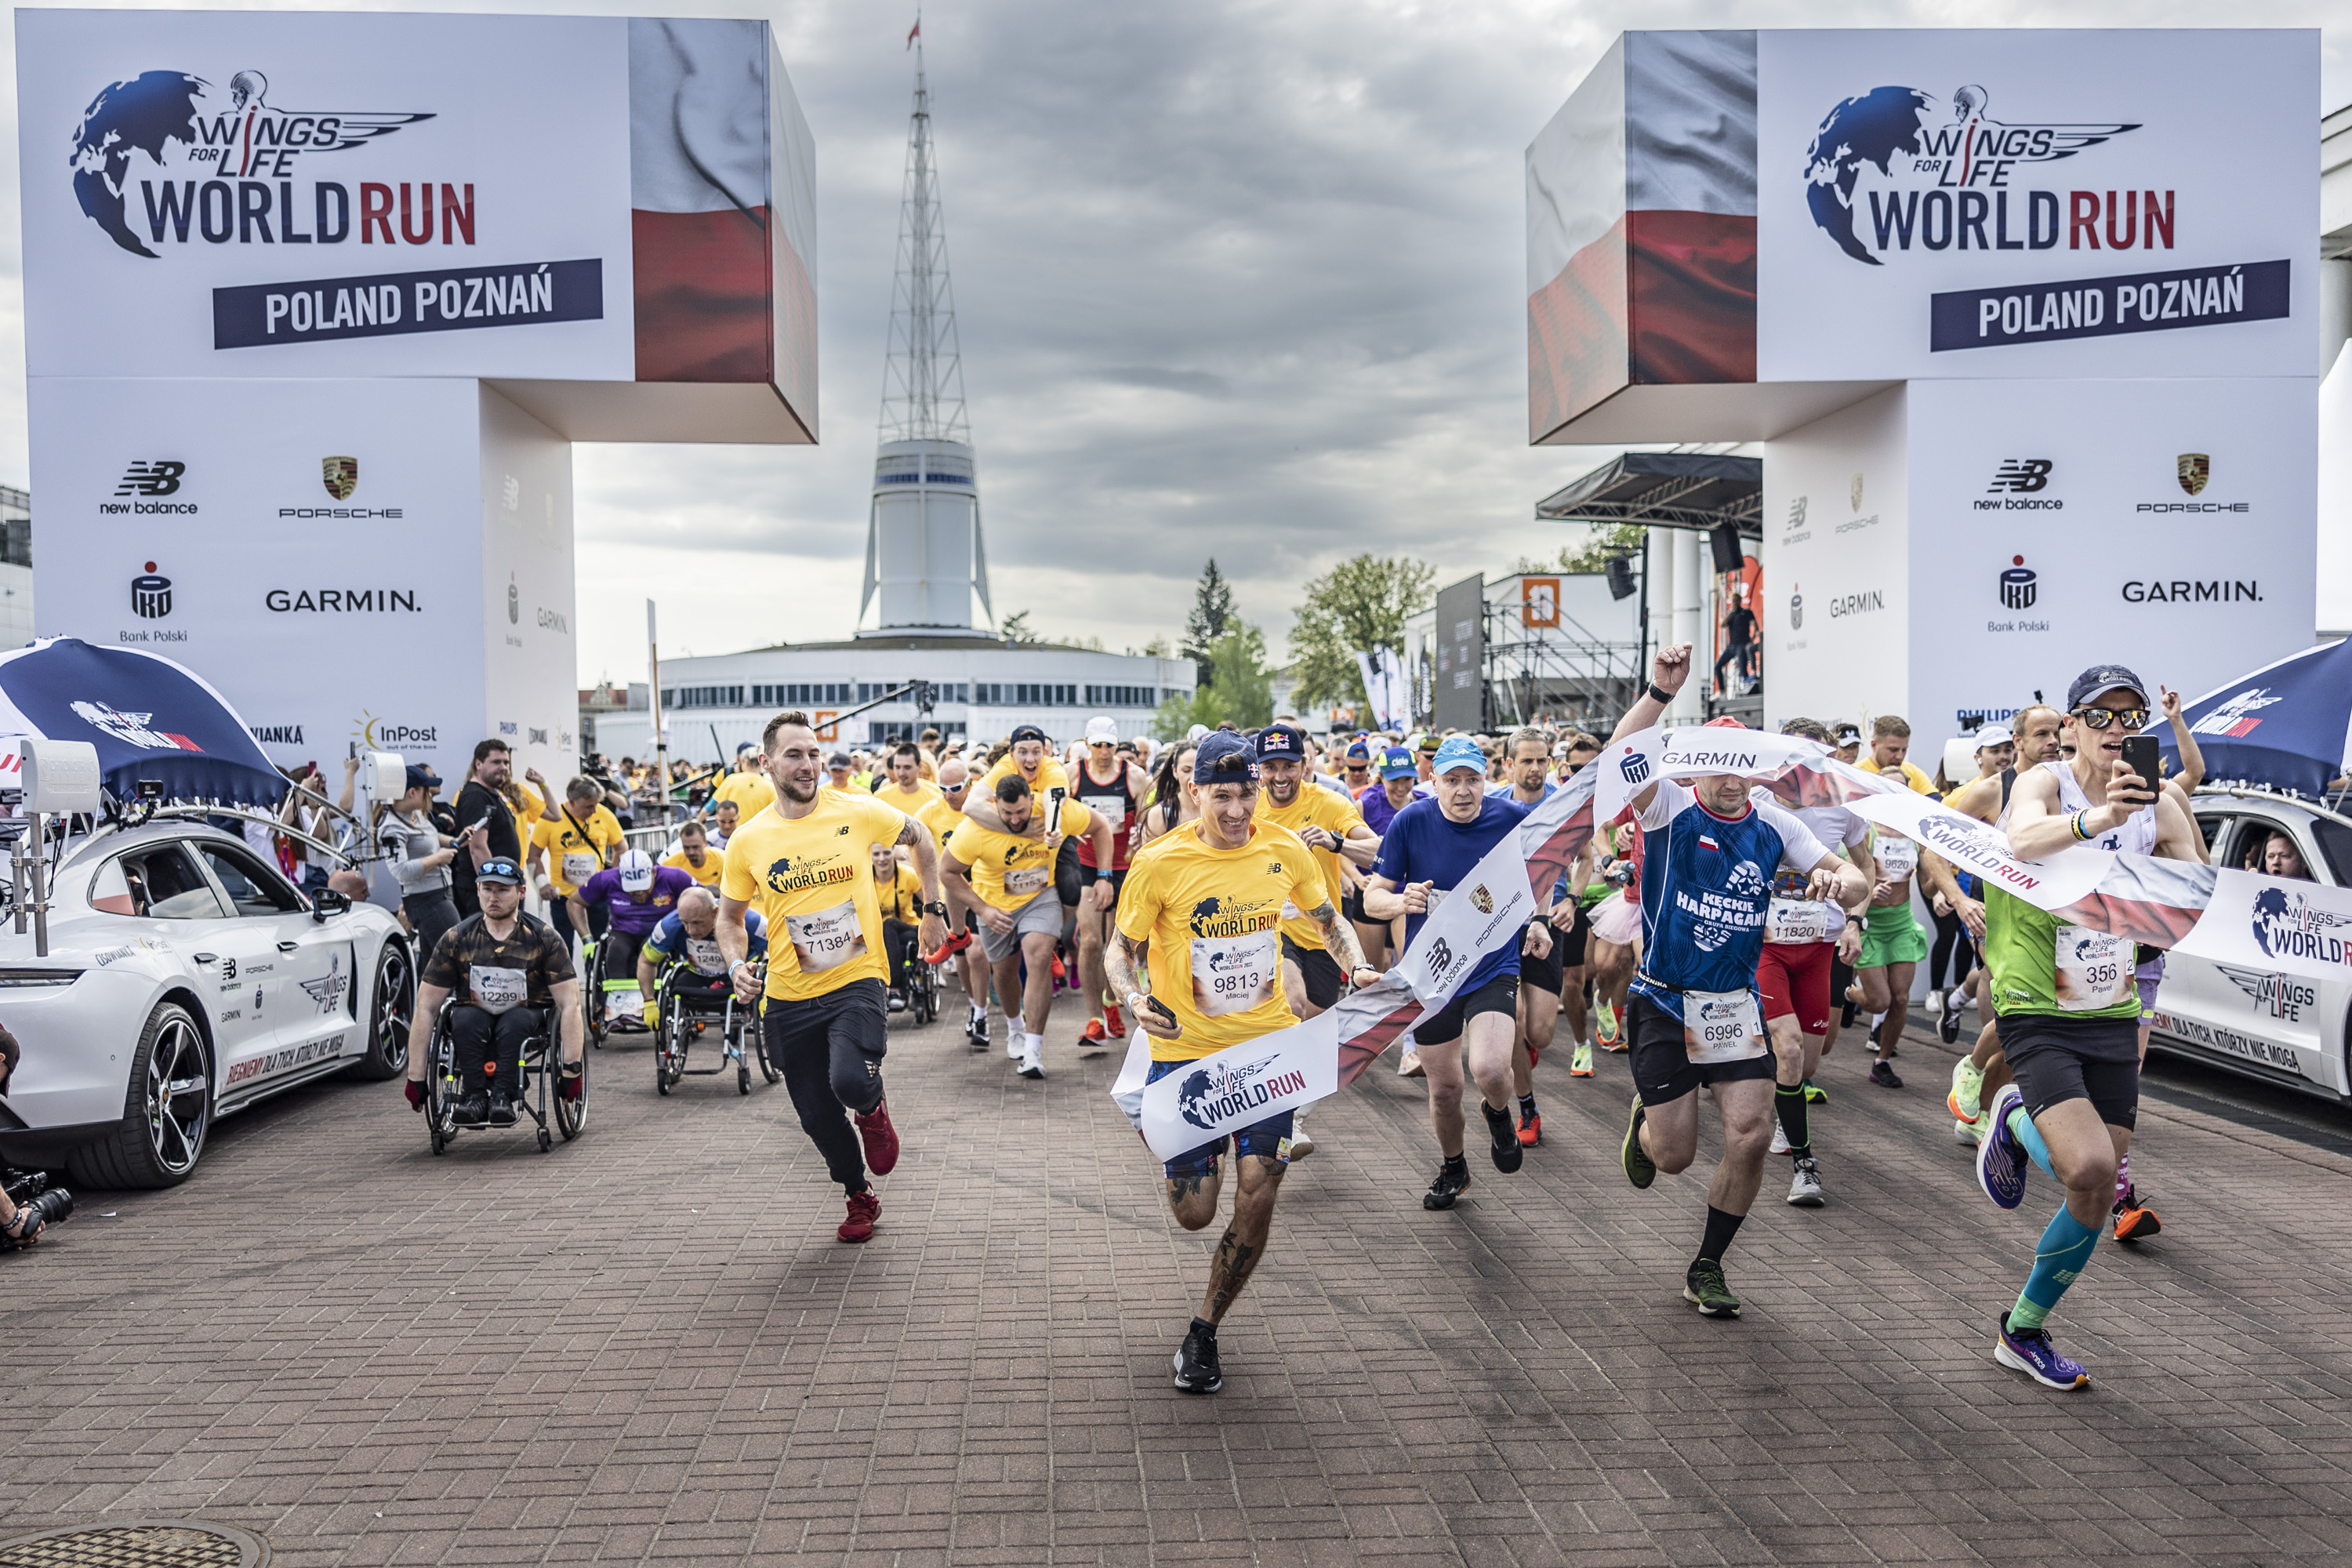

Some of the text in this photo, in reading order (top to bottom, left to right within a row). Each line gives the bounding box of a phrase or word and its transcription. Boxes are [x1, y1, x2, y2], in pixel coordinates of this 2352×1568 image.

[189, 148, 219, 161] FOR
[1914, 160, 1941, 172] FOR
[142, 181, 476, 245] WORLD RUN
[1869, 190, 2175, 249] WORLD RUN
[266, 265, 552, 334] POLAND POZNAŃ
[1980, 267, 2244, 337] POLAND POZNAŃ
[101, 502, 198, 515] new balance
[1974, 498, 2063, 510] new balance
[2137, 503, 2249, 512] PORSCHE
[279, 509, 402, 518] PORSCHE
[1836, 515, 1878, 534] PORSCHE
[1988, 620, 2049, 633] Bank Polski
[121, 631, 187, 643] Bank Polski
[381, 726, 437, 741] InPost
[1885, 859, 1909, 869] 9620
[1932, 830, 2040, 890] WORLD RUN
[781, 865, 853, 891] WORLD RUN
[1703, 892, 1754, 912] KĘCKIE
[1206, 917, 1257, 937] WORLD
[1475, 891, 1522, 948] PORSCHE
[1704, 920, 1723, 928] GRUPA
[1775, 927, 1814, 937] 11820
[806, 932, 851, 954] 71384
[2274, 928, 2341, 963] WORLD
[95, 945, 136, 967] CISOWIANKA
[2127, 959, 2133, 971] 2
[246, 964, 274, 974] PORSCHE
[1268, 967, 1274, 976] 4
[1436, 954, 1468, 994] new balance
[2086, 963, 2117, 984] 356
[1215, 973, 1258, 993] 9813
[2092, 984, 2112, 993] Paweł
[481, 992, 517, 1002] 12299
[1226, 991, 1249, 1000] Maciej
[221, 1009, 241, 1023] GARMIN
[1705, 1023, 1743, 1041] 6996
[1754, 1022, 1759, 1032] 1
[2173, 1017, 2189, 1036] DLA
[2214, 1028, 2252, 1056] KTÓRZY
[2250, 1040, 2269, 1061] NIE
[2268, 1044, 2303, 1075] MOGĄ
[227, 1058, 265, 1085] BIEGNIEMY
[262, 1054, 277, 1074] DLA
[1202, 1070, 1306, 1124] WORLD RUN
[2011, 1342, 2045, 1370] new balance
